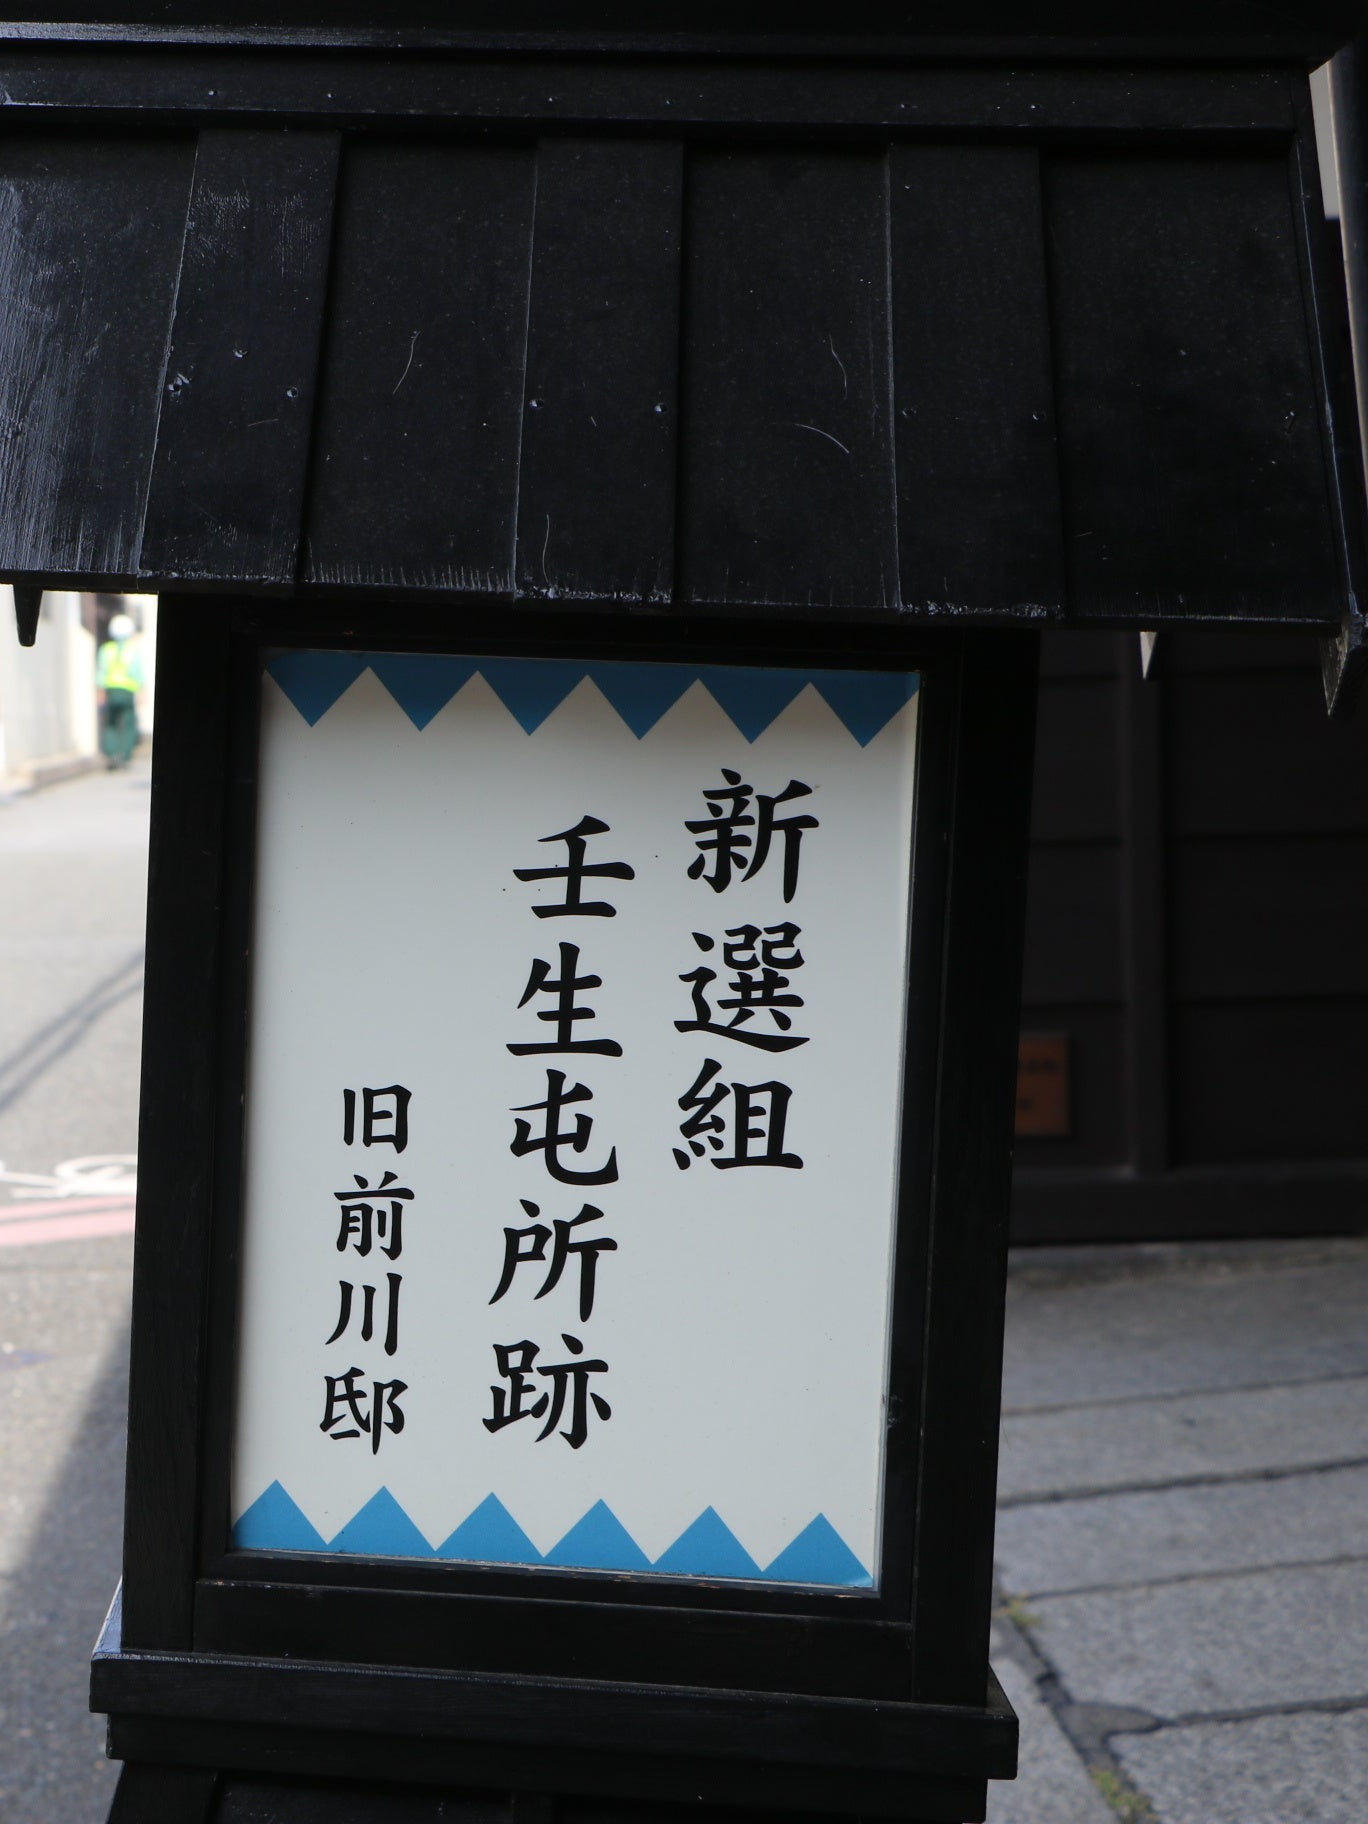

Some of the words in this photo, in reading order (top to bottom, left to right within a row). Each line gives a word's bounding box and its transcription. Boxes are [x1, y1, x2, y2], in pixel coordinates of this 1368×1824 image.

[482, 814, 636, 1450] 壬生屯所跡
[672, 767, 820, 1171] 新選組
[319, 1083, 415, 1455] 旧前川邸
